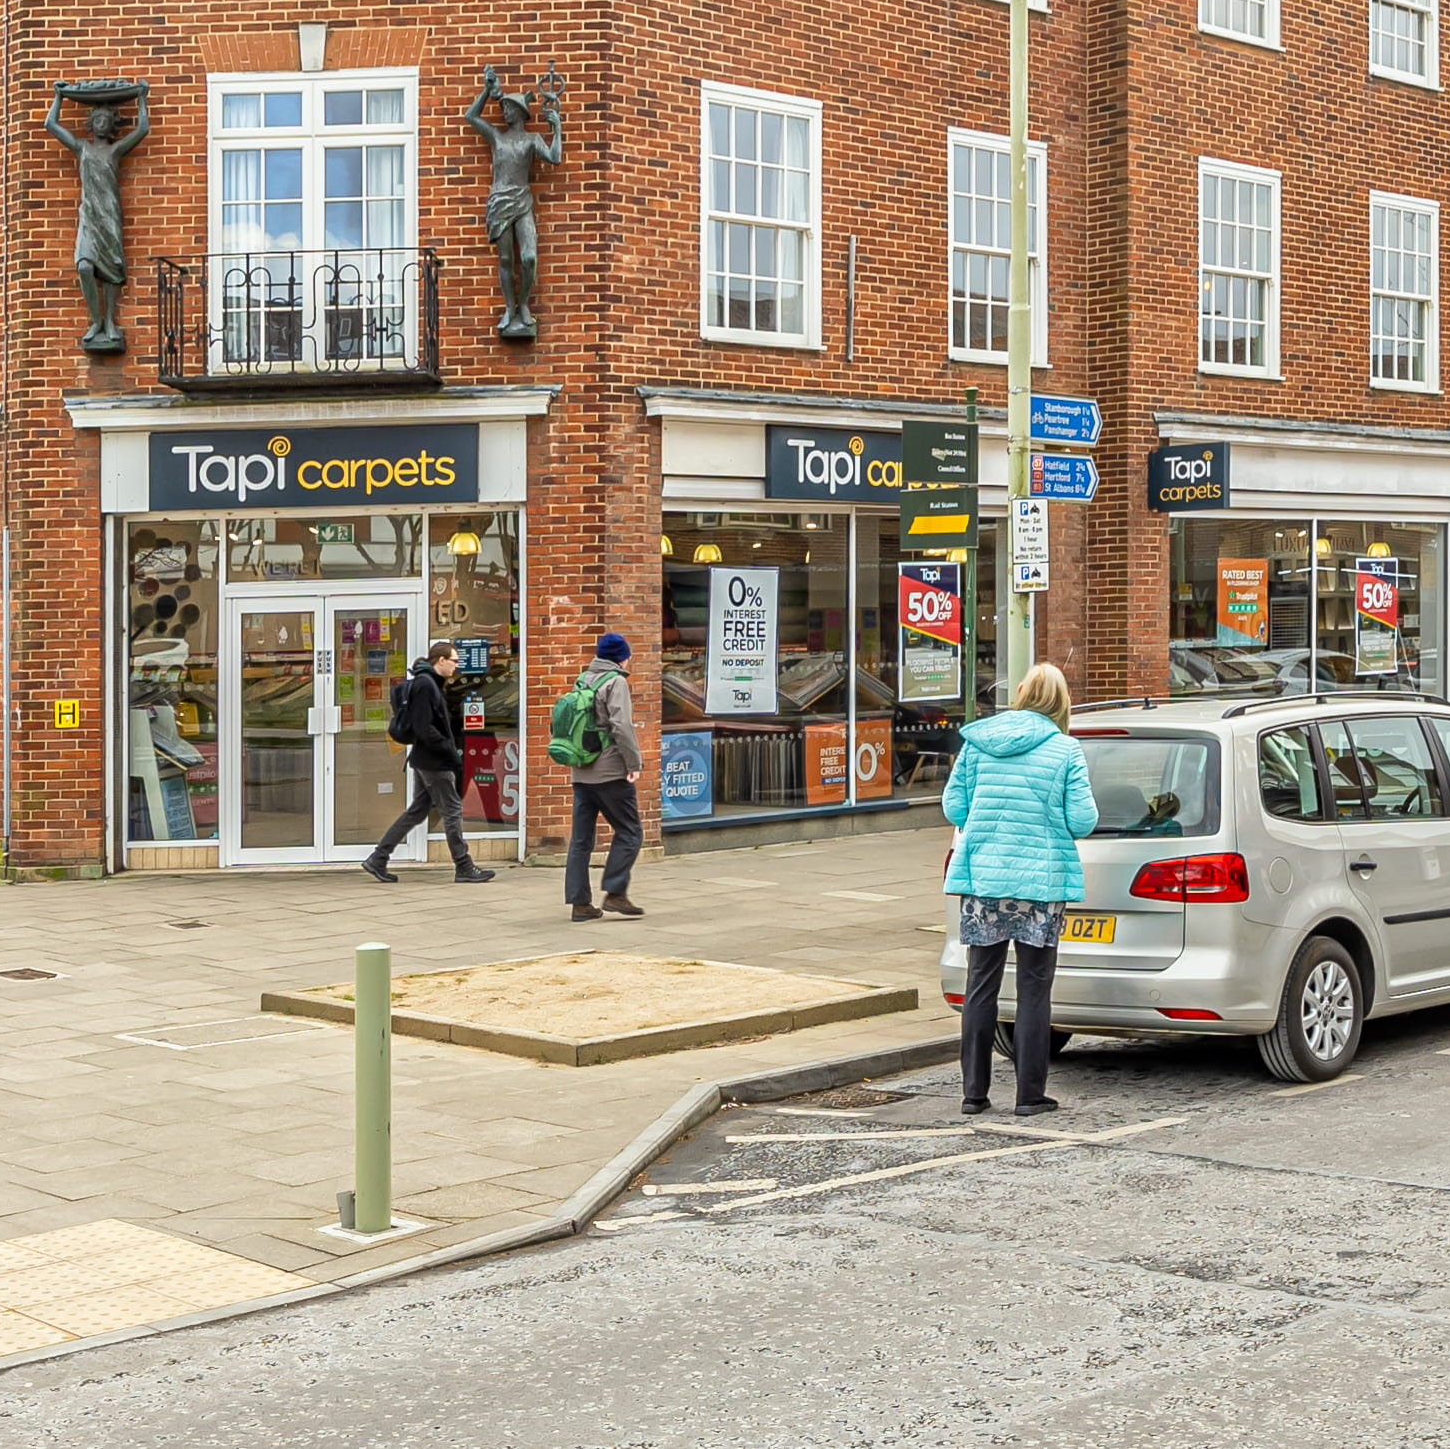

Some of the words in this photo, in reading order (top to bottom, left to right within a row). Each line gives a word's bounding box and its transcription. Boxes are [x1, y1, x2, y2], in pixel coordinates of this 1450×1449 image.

[171, 435, 291, 502] Tapi
[296, 449, 457, 495] carpets
[787, 435, 865, 495] Tapi
[1044, 461, 1070, 471] Hatfield
[1163, 450, 1214, 484] Tapi
[1053, 483, 1074, 494] Albans
[1159, 481, 1222, 503] carpets
[919, 566, 942, 583] Tapi
[1222, 570, 1246, 580] RATED
[1246, 570, 1264, 580] BEST
[728, 576, 763, 607] 0%
[1362, 583, 1393, 609] 50%
[907, 591, 953, 622] 50%
[723, 610, 767, 620] INTEREST
[937, 612, 953, 621] OFF
[723, 621, 767, 638] FREE
[723, 639, 766, 651] CREDIT
[722, 659, 734, 667] NO
[735, 659, 765, 667] DEPOSIT
[732, 688, 753, 703] Tapi
[59, 702, 76, 724] H
[666, 760, 691, 773] BEAT
[820, 756, 839, 766] FREE
[856, 742, 886, 781] 0%
[672, 772, 705, 785] FITTED
[665, 784, 699, 798] QUOTE
[1071, 917, 1108, 939] OZT
